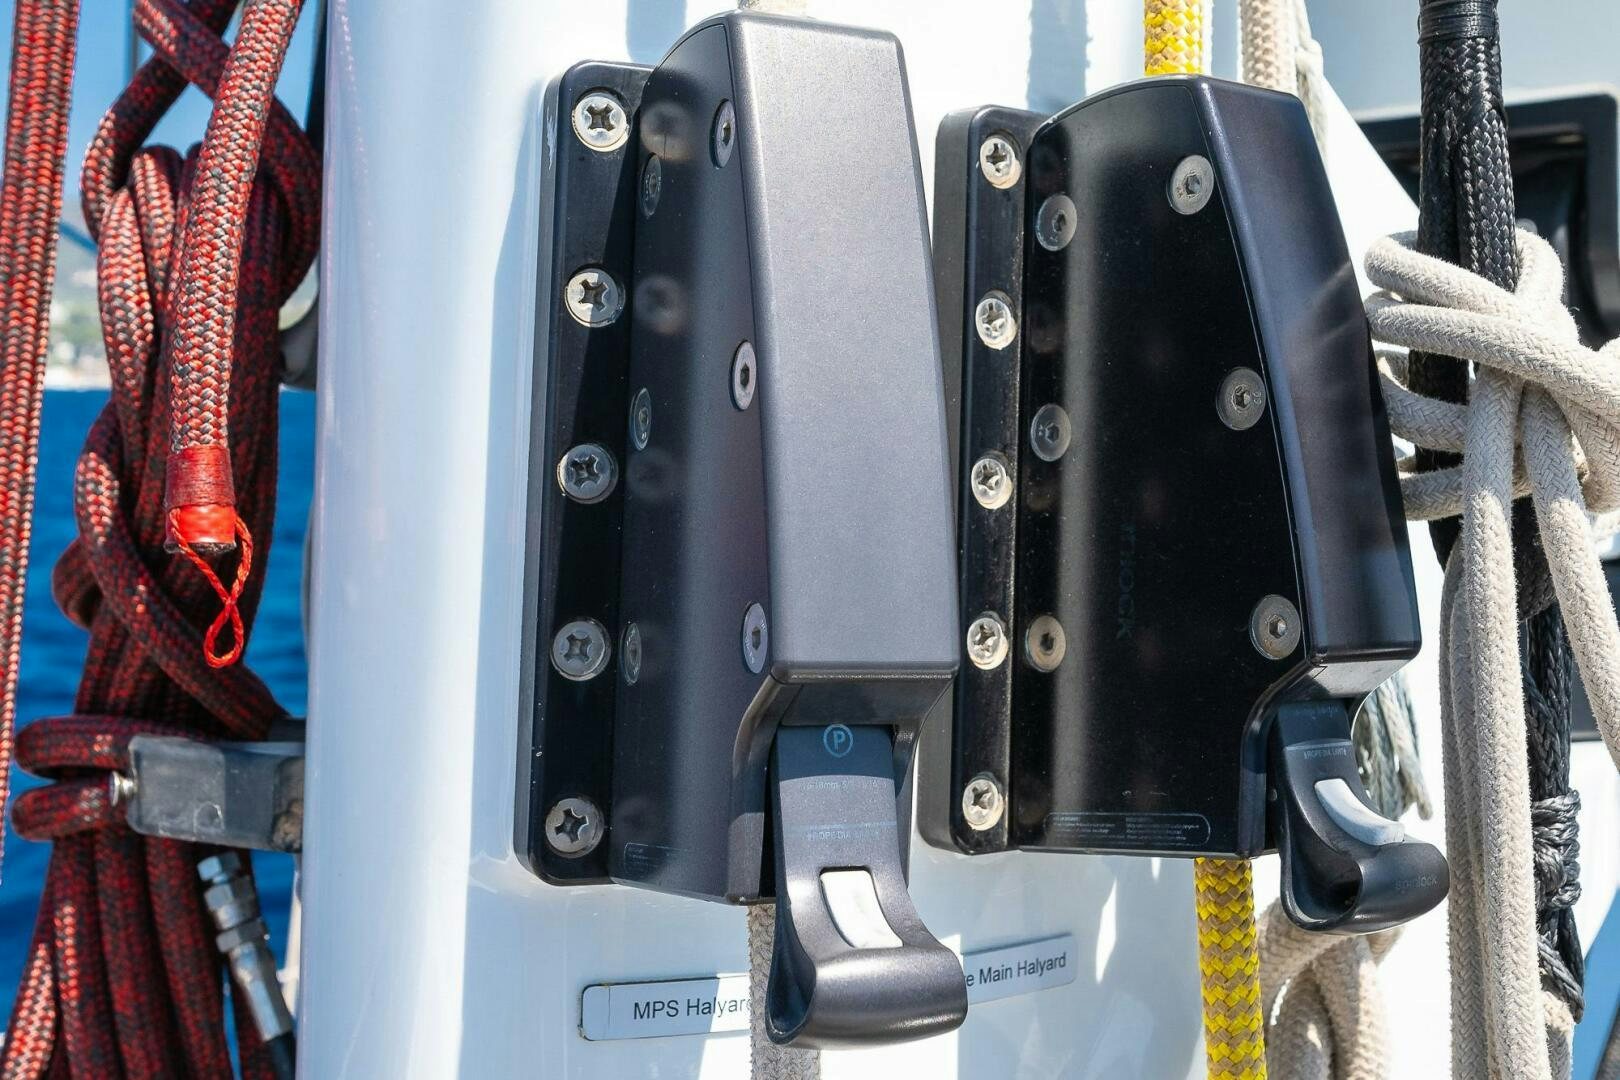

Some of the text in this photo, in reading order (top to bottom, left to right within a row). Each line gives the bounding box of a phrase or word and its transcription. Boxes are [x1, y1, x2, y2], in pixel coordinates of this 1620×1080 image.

[979, 964, 1013, 985] Main
[1017, 951, 1067, 977] Halyard
[633, 999, 679, 1020] MPS
